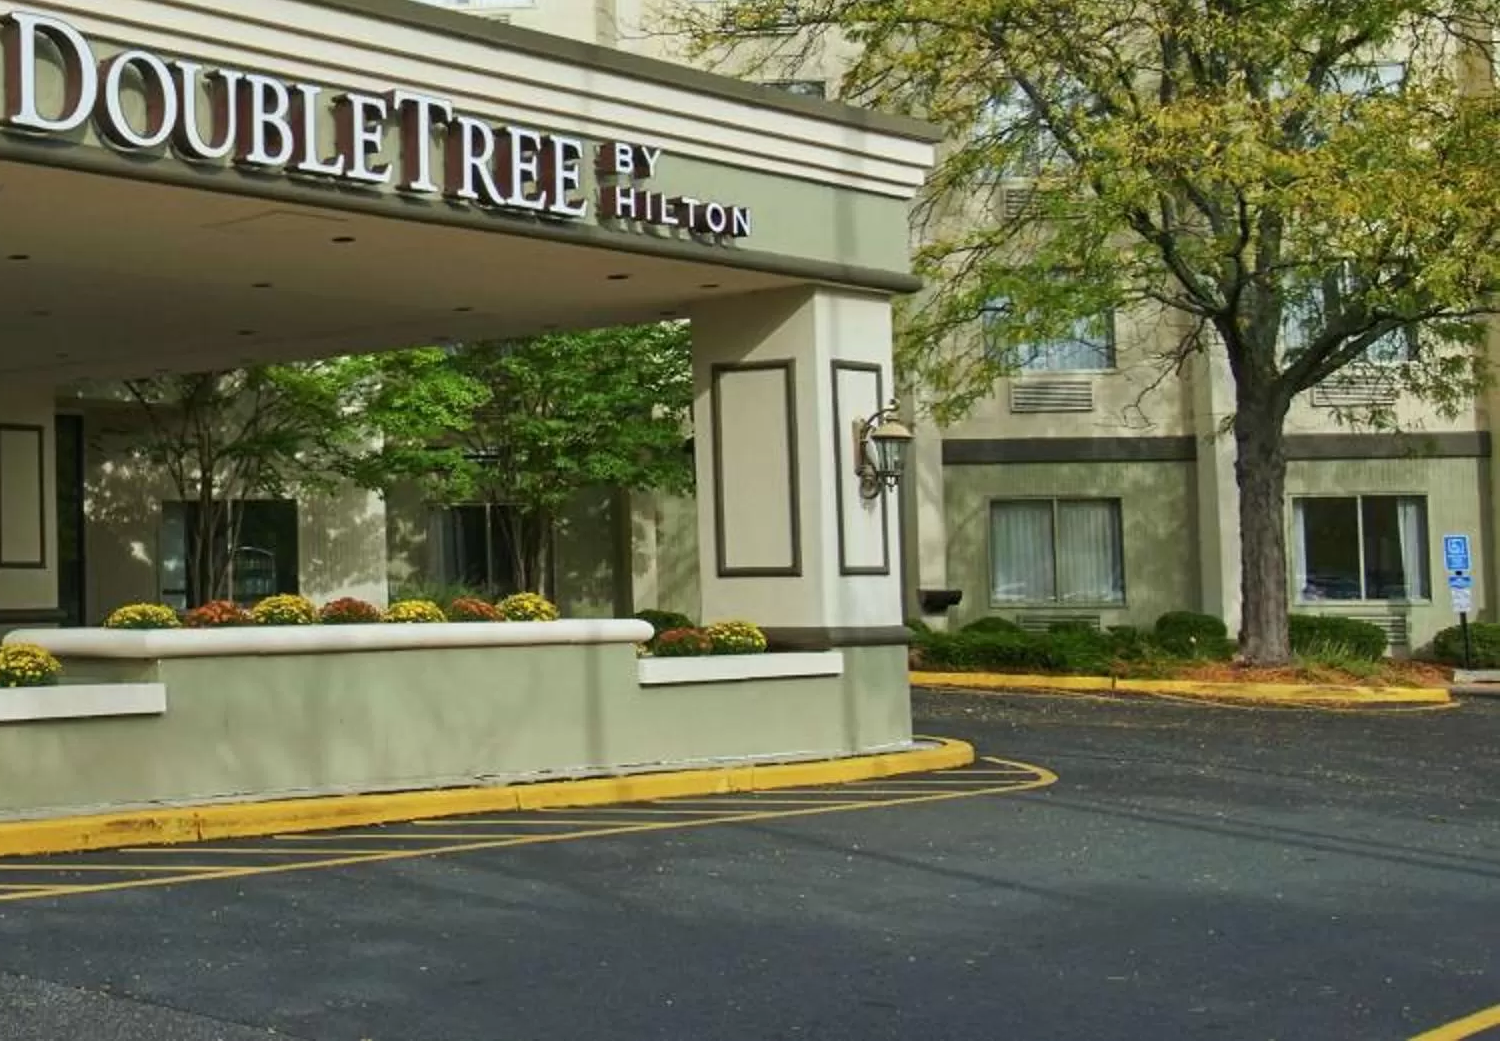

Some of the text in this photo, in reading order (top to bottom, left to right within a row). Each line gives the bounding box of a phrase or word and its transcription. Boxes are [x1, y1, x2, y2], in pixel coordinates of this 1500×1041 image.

[7, 11, 588, 218] DOUBLETREE
[615, 142, 661, 176] BY
[615, 185, 750, 236] HILTON
